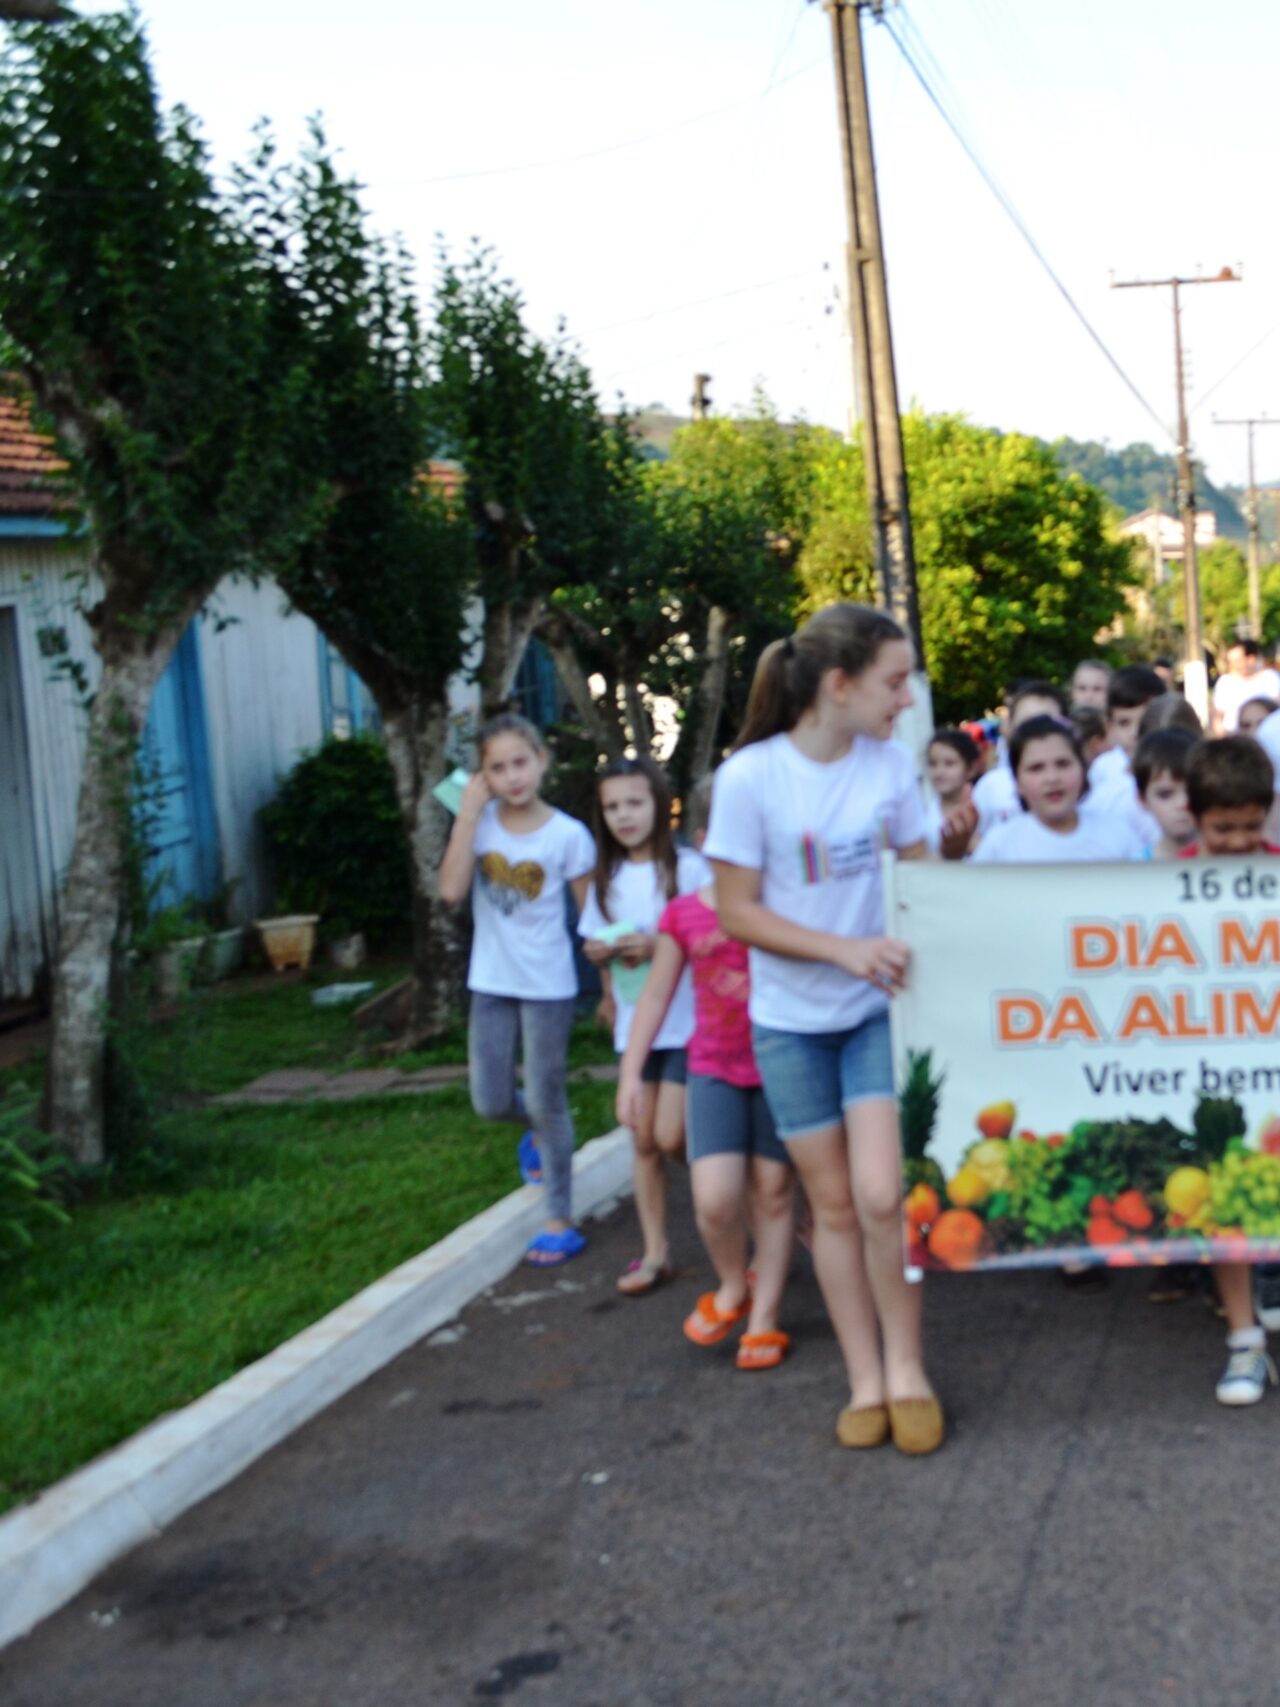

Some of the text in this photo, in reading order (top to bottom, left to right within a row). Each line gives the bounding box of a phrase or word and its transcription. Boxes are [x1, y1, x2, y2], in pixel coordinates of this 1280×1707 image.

[1178, 868, 1221, 901] 16
[1232, 865, 1277, 900] de
[1071, 921, 1197, 970] DIA
[997, 995, 1099, 1042] DA
[1082, 1060, 1186, 1095] Viver
